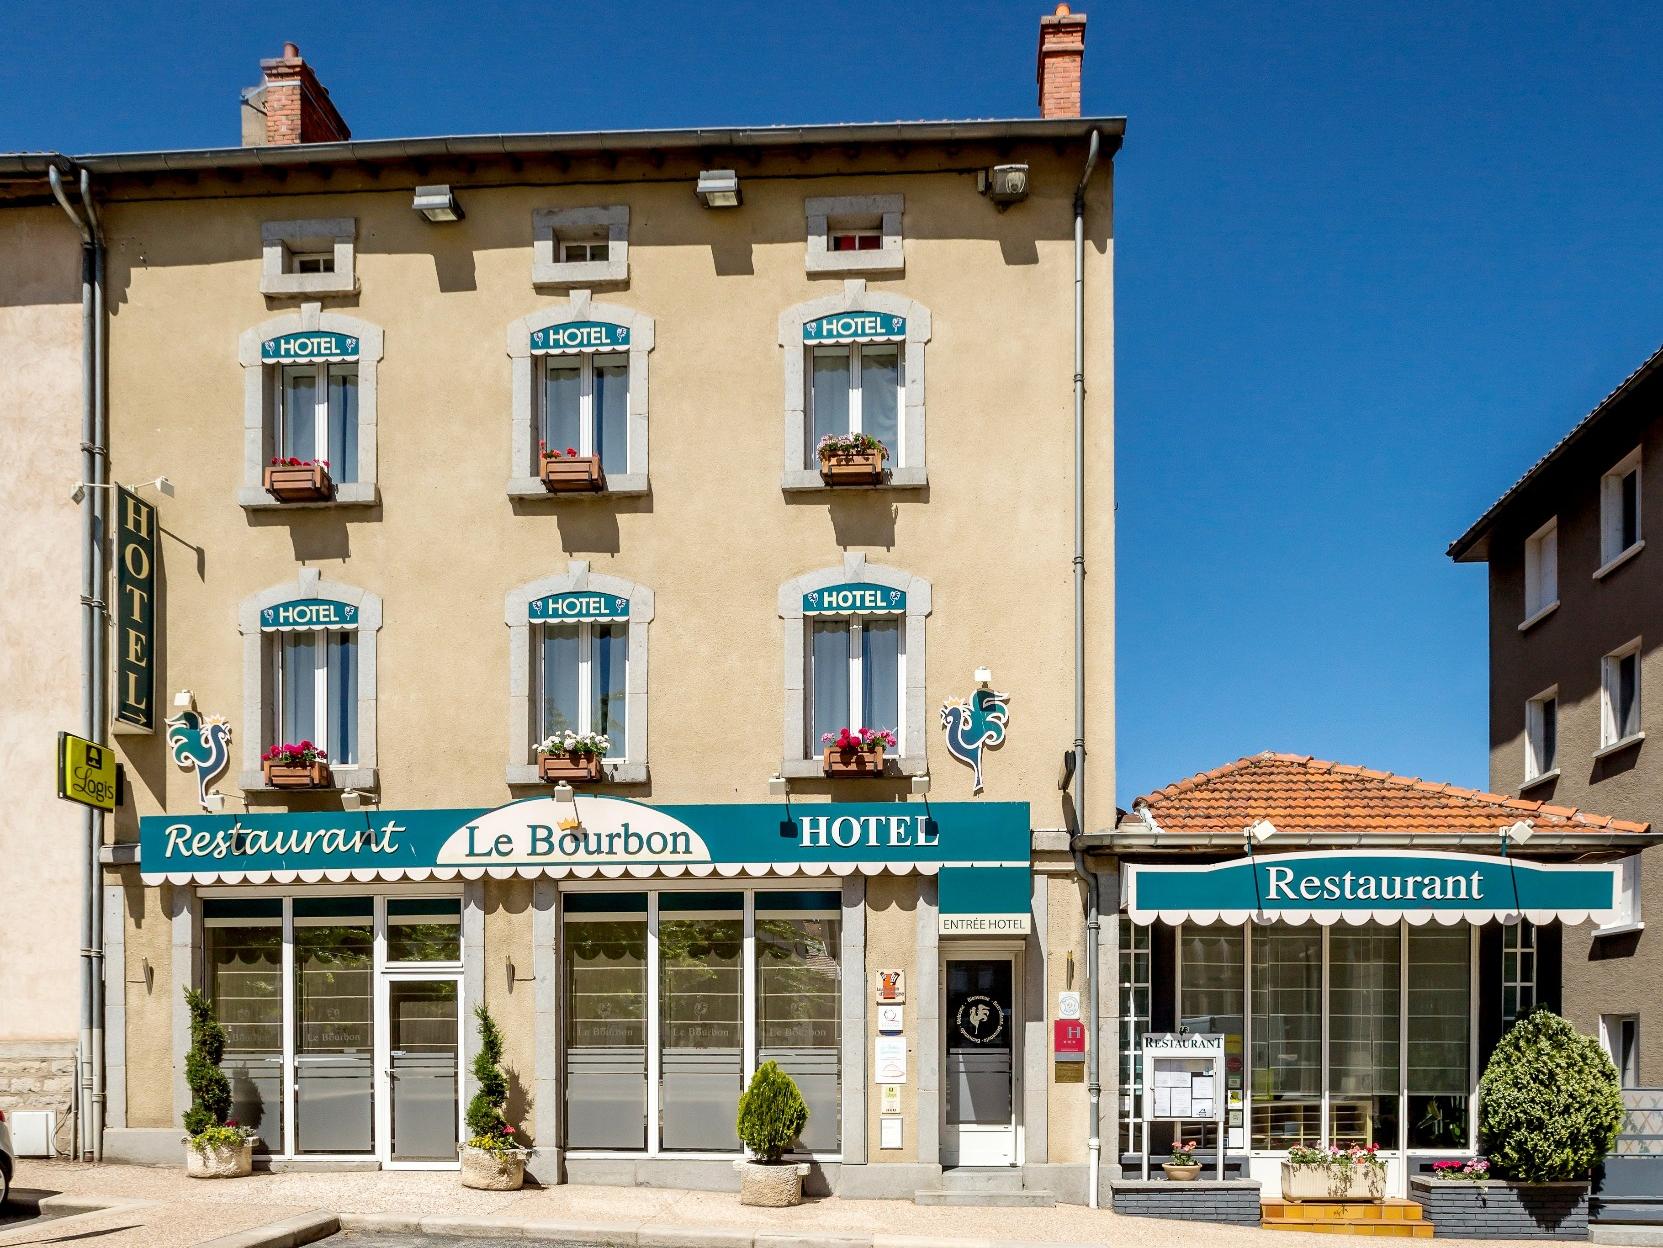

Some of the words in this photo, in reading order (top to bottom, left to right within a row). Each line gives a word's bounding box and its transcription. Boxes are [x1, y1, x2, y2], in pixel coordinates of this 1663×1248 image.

[822, 317, 886, 336] HOTEL
[550, 328, 610, 346] HOTEL
[280, 338, 340, 355] HOTEL
[124, 494, 150, 711] HOTEL
[548, 598, 609, 615] HOTEL
[823, 590, 886, 607] HOTEL
[279, 605, 339, 623] HOTEL
[73, 766, 114, 802] Logis
[165, 820, 406, 859] Restaurant
[465, 826, 514, 857] Le
[527, 822, 693, 856] Bourbon
[799, 816, 940, 847] HOTEL
[1265, 867, 1484, 900] Restaurant
[943, 917, 986, 930] ENTRÉE
[988, 918, 1025, 930] HOTEL
[1145, 1037, 1223, 1048] RESTAURANT
